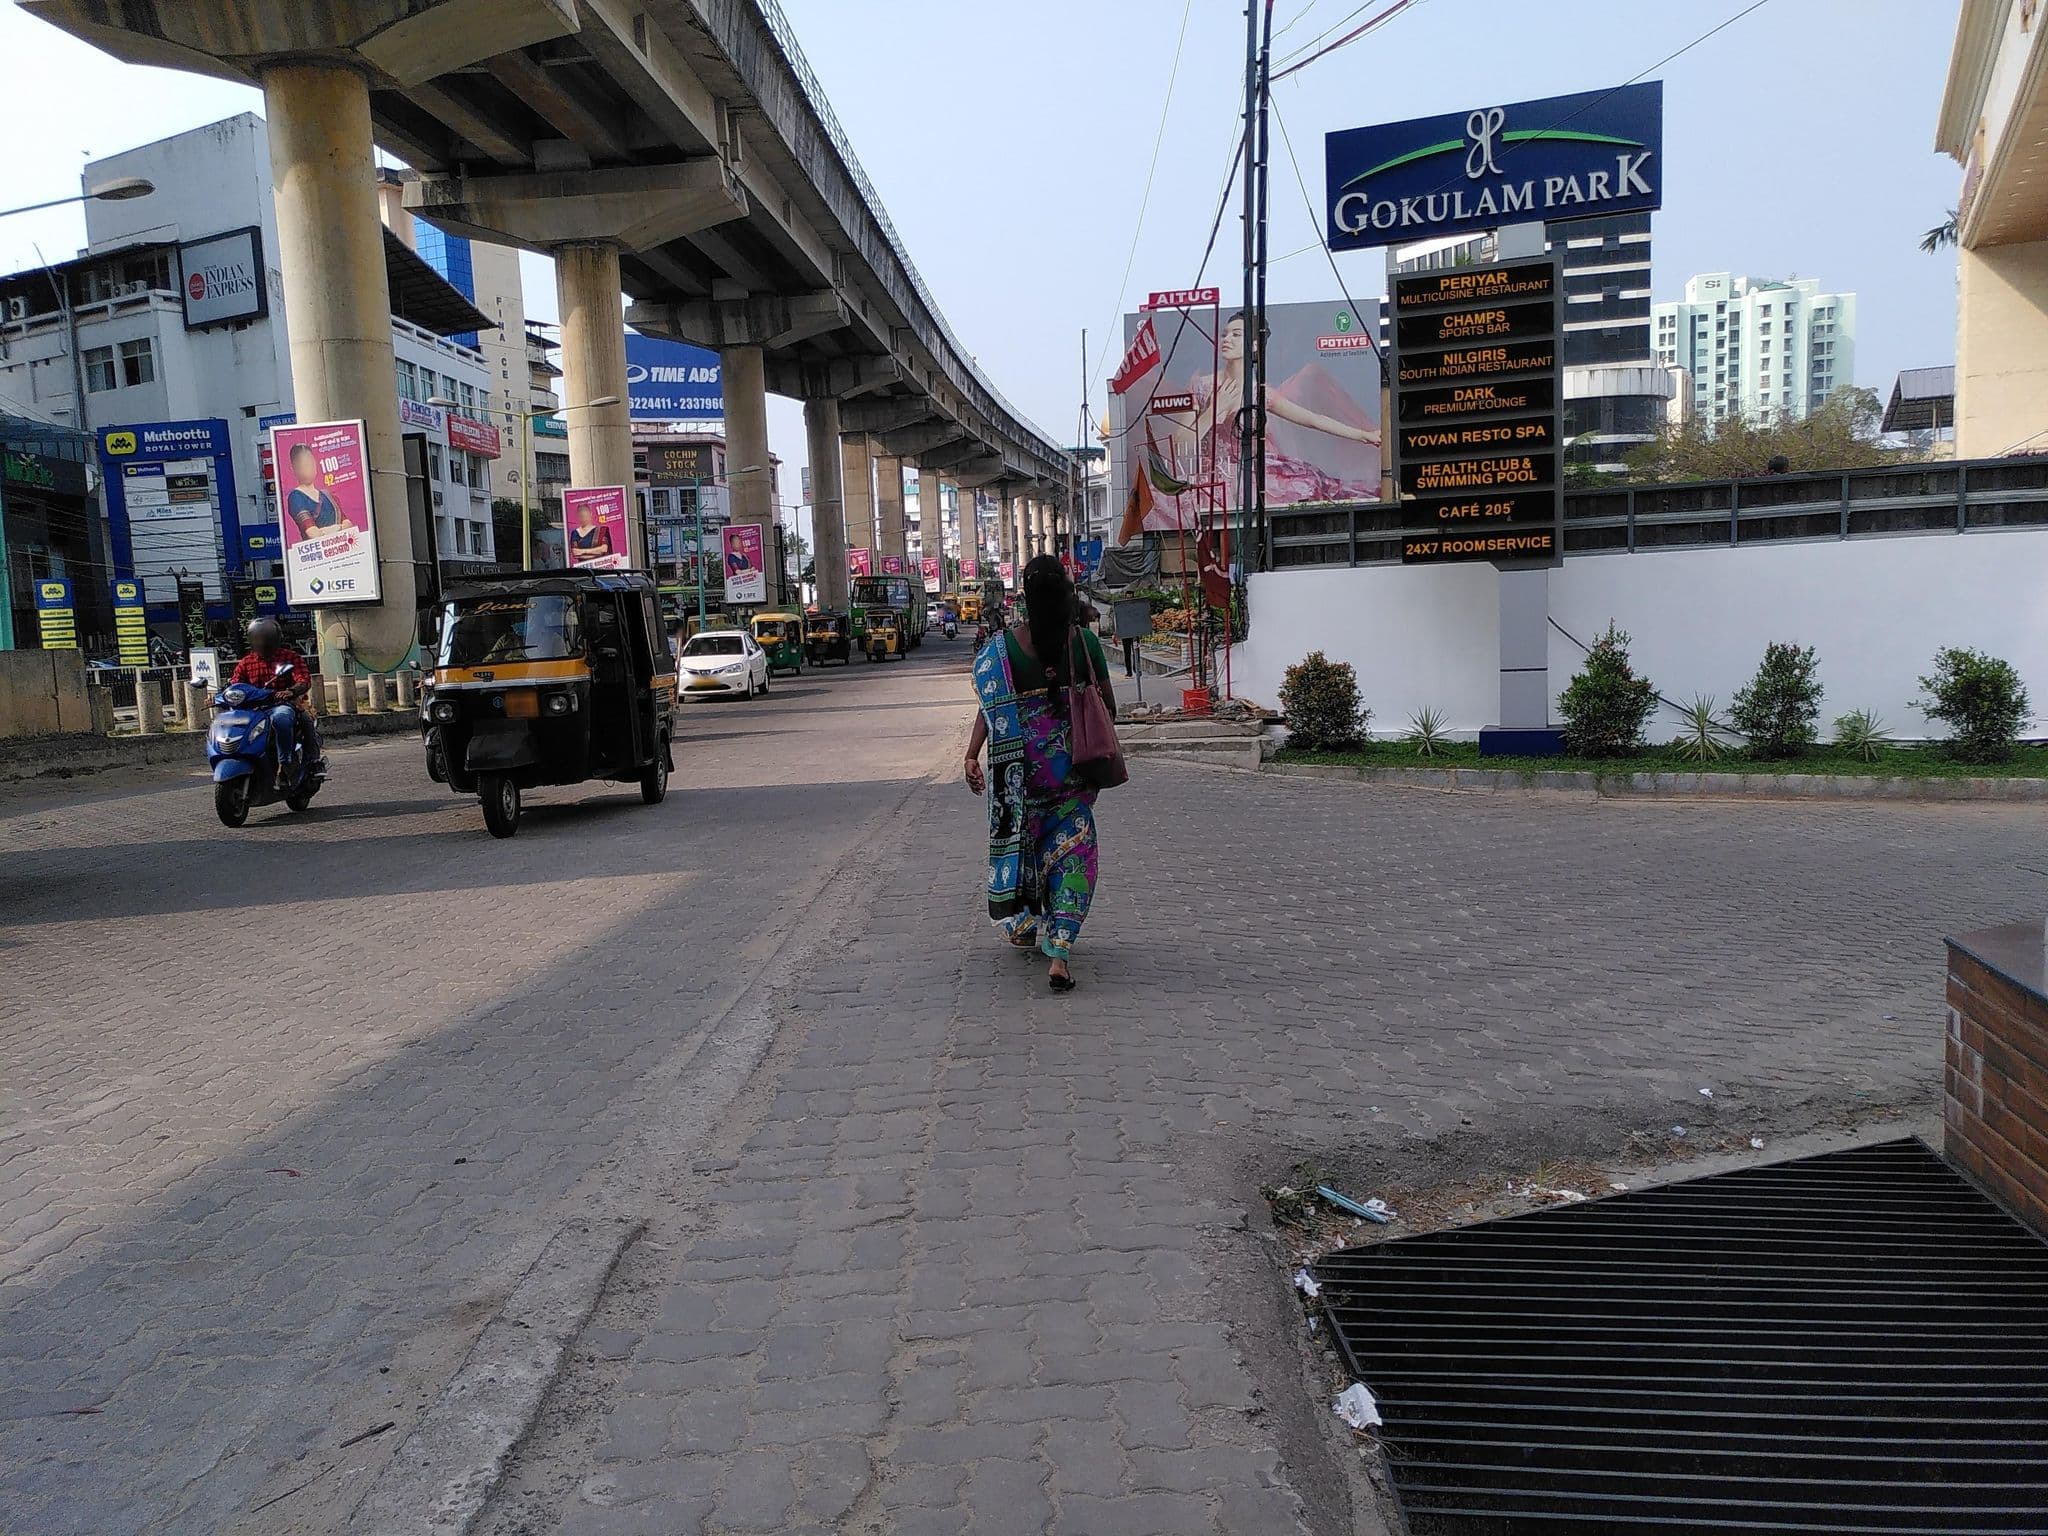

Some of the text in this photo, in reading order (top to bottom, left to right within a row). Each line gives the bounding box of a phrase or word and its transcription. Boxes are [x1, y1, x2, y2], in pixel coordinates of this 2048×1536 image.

[1334, 151, 1653, 234] GOKULAM PARK
[205, 263, 244, 285] INDIAN
[1440, 272, 1508, 290] PERIYAR
[207, 276, 254, 299] EXPRESS
[1401, 279, 1550, 305] MULTICUISINE RESTAURANT
[1156, 289, 1213, 305] AITUC
[1443, 311, 1506, 328] CHAMPS
[1439, 323, 1511, 339] SPORTS BAR
[1320, 337, 1368, 348] POTHYS
[1443, 348, 1507, 366] NILGIRIS
[651, 367, 718, 382] TIME ADS
[1400, 356, 1553, 380] SOUTH INDIAN RESTAURANT
[1454, 387, 1495, 401] DARK
[1153, 397, 1192, 409] AIUWC
[1424, 396, 1527, 415] PREMIUM LOUNGE
[144, 429, 210, 443] Muthoottu
[1408, 425, 1546, 447] YOVAN RESTO SPA
[145, 442, 212, 453] ROYAL TOWER
[664, 450, 697, 459] COCHIN
[320, 456, 339, 474] 100
[666, 461, 697, 469] STOCK
[1422, 458, 1532, 476] HEALTH CLUB &
[1417, 470, 1538, 489] SWIMMING POOL
[1439, 502, 1480, 519] CAFÉ
[298, 541, 321, 555] KSFE
[1406, 536, 1551, 555] 24X7 ROOM SERVICE
[327, 579, 356, 590] KSFE
